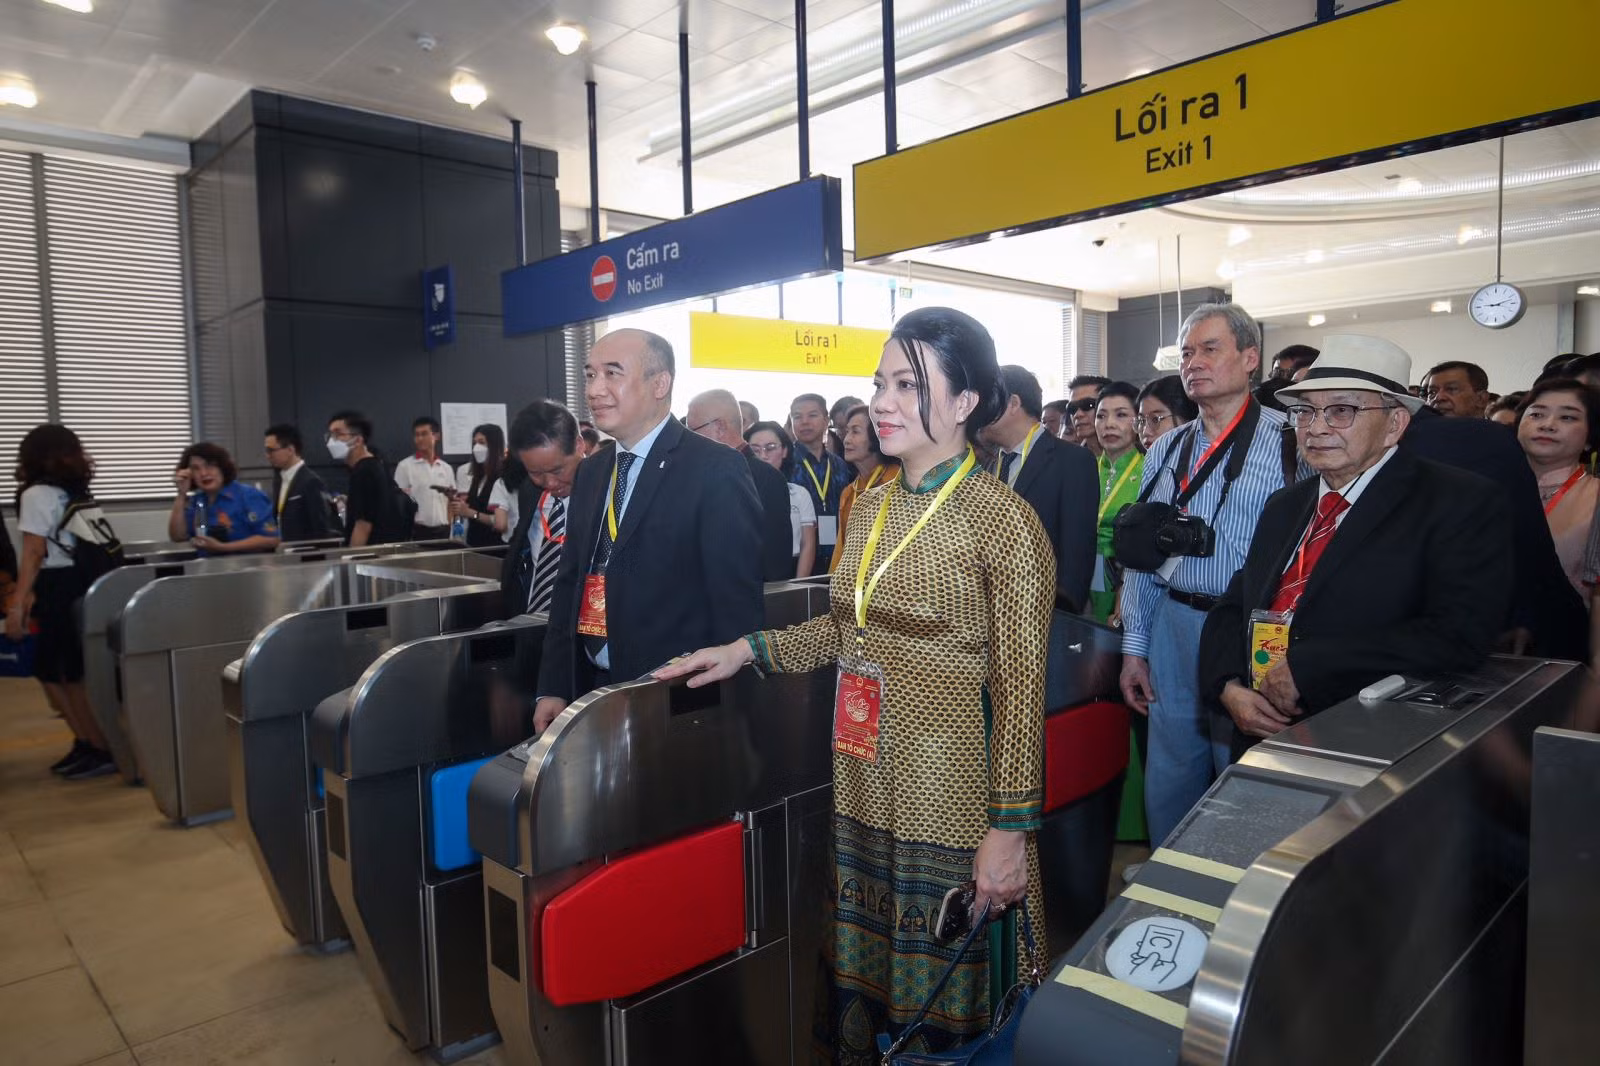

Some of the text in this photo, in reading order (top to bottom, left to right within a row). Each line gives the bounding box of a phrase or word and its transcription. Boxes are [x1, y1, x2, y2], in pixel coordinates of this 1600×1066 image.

[1115, 72, 1248, 142] Lối ra 1
[1146, 135, 1211, 174] Exit 1
[626, 241, 680, 271] Cấm ra
[627, 272, 664, 295] No Exit
[795, 329, 837, 349] Lối ra 1
[806, 352, 822, 365] Exit
